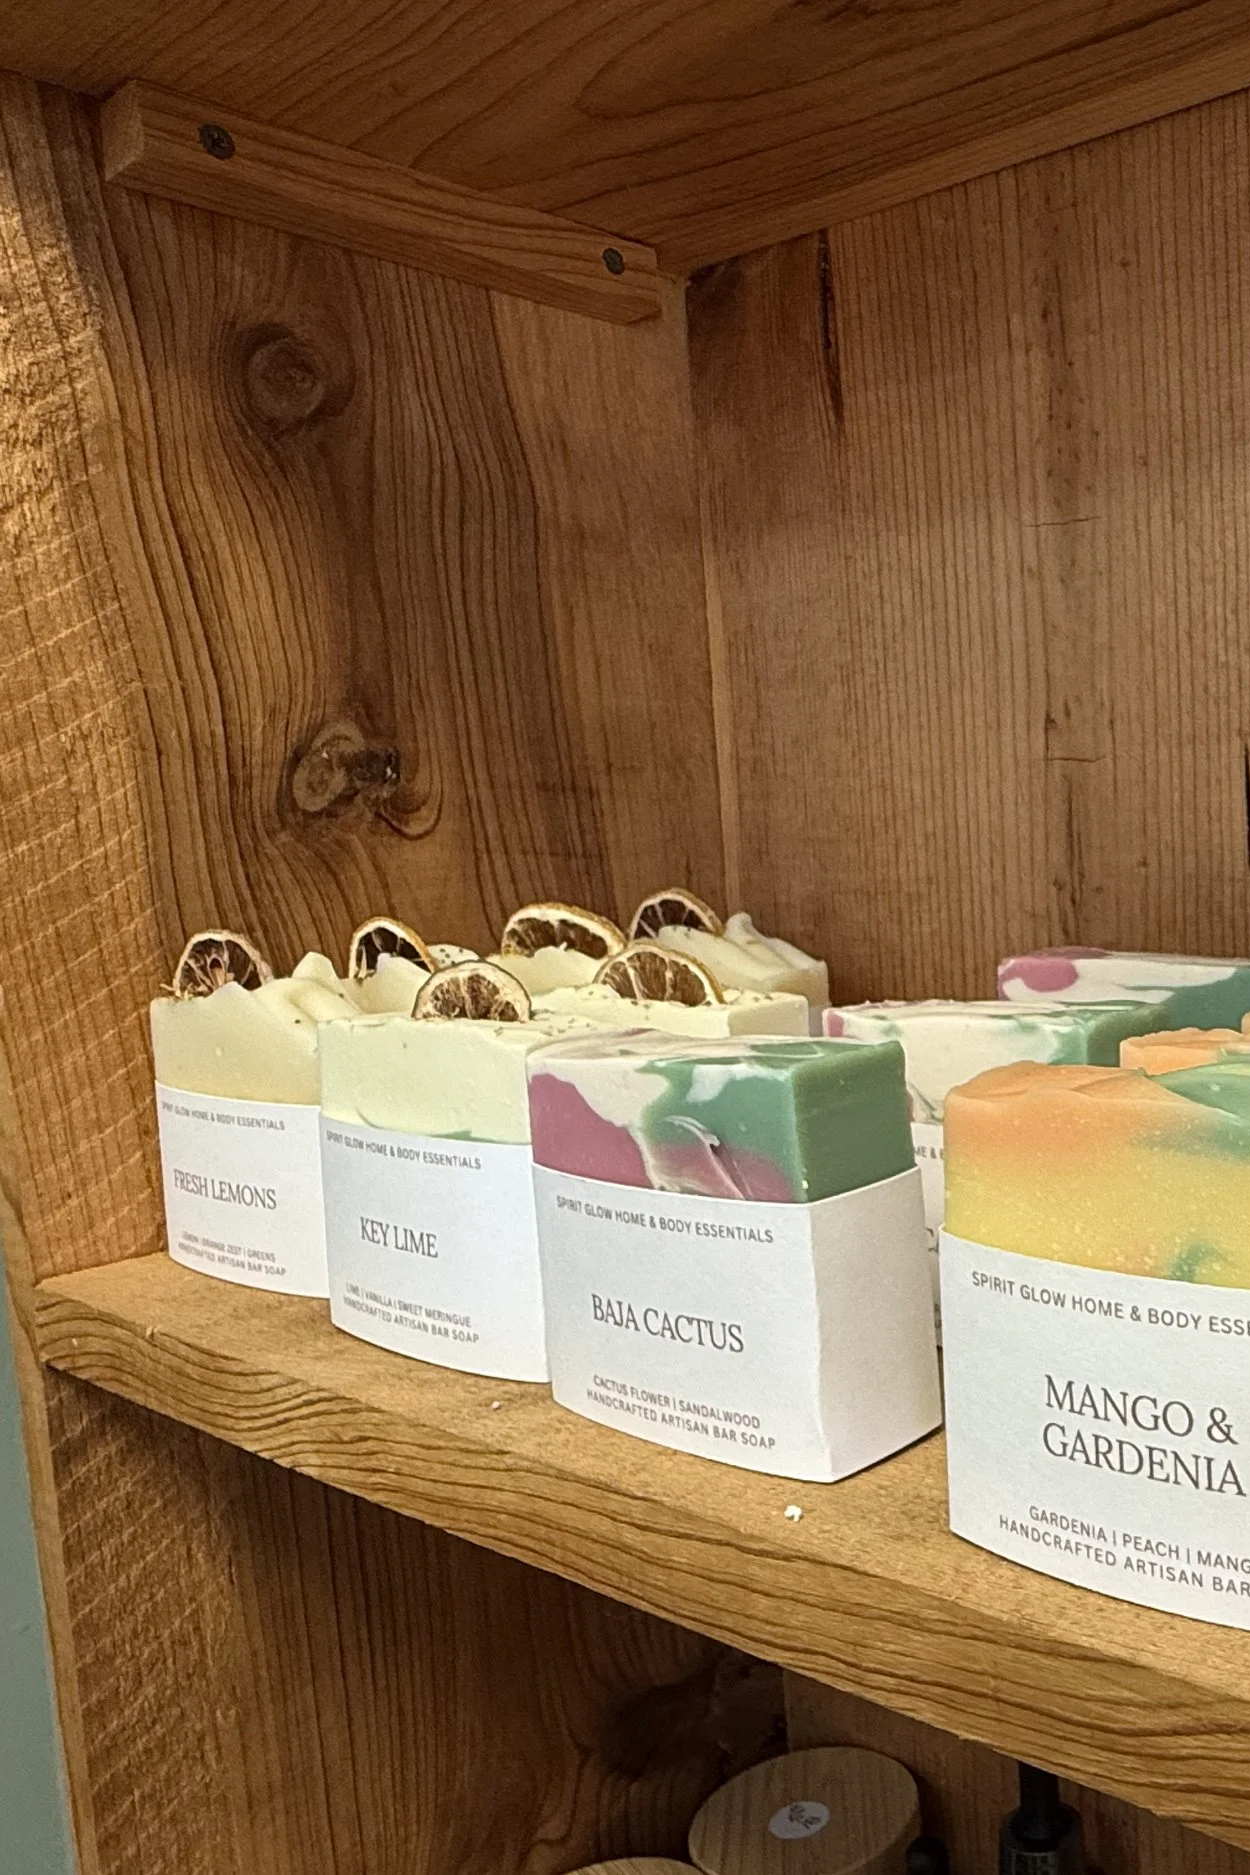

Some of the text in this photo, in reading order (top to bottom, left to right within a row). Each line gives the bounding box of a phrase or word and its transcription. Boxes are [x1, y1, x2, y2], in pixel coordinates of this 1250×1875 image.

[237, 1116, 285, 1130] ESSENTIALS
[345, 1136, 364, 1149] GLOW
[366, 1139, 387, 1156] HOME
[397, 1147, 421, 1161] BODY
[423, 1152, 481, 1169] ESSENTIALS
[174, 1168, 277, 1210] FRESH LEMONS
[360, 1216, 438, 1258] KEY LIME
[556, 1195, 774, 1243] SPIRIT GLOW HOME & BODY ESSENTIALS
[217, 1255, 245, 1269] ARTISAN
[248, 1261, 262, 1272] BAR
[265, 1264, 286, 1276] SOAP
[247, 1247, 275, 1263] GREENS
[399, 1300, 422, 1316] SWEET
[424, 1308, 472, 1327] MERINGUE
[591, 1293, 744, 1353] BAJA CACTUS
[972, 1270, 1015, 1296] SPIRIT
[1020, 1284, 1066, 1309] GLOW
[1072, 1295, 1124, 1319] HOME
[1130, 1305, 1141, 1321] &
[1149, 1308, 1201, 1331] BODY
[394, 1314, 428, 1332] ARTISAN
[431, 1324, 449, 1337] BAR
[452, 1329, 479, 1343] SOAP
[587, 1389, 775, 1449] HANDCRAFTED ARTISAN BAR SOAP
[594, 1374, 628, 1396] CACTUS
[631, 1386, 670, 1408] FLOWER
[679, 1400, 760, 1429] SANDALWOOD
[1044, 1374, 1239, 1445] MANGO &
[1043, 1422, 1247, 1497] GARDENIA
[1000, 1514, 1117, 1566] HANDCRAFTED
[1124, 1556, 1204, 1588] ARTISAN
[1212, 1576, 1250, 1597] BAR
[1029, 1505, 1107, 1543] GARDENIA
[1123, 1533, 1180, 1561] PEACH
